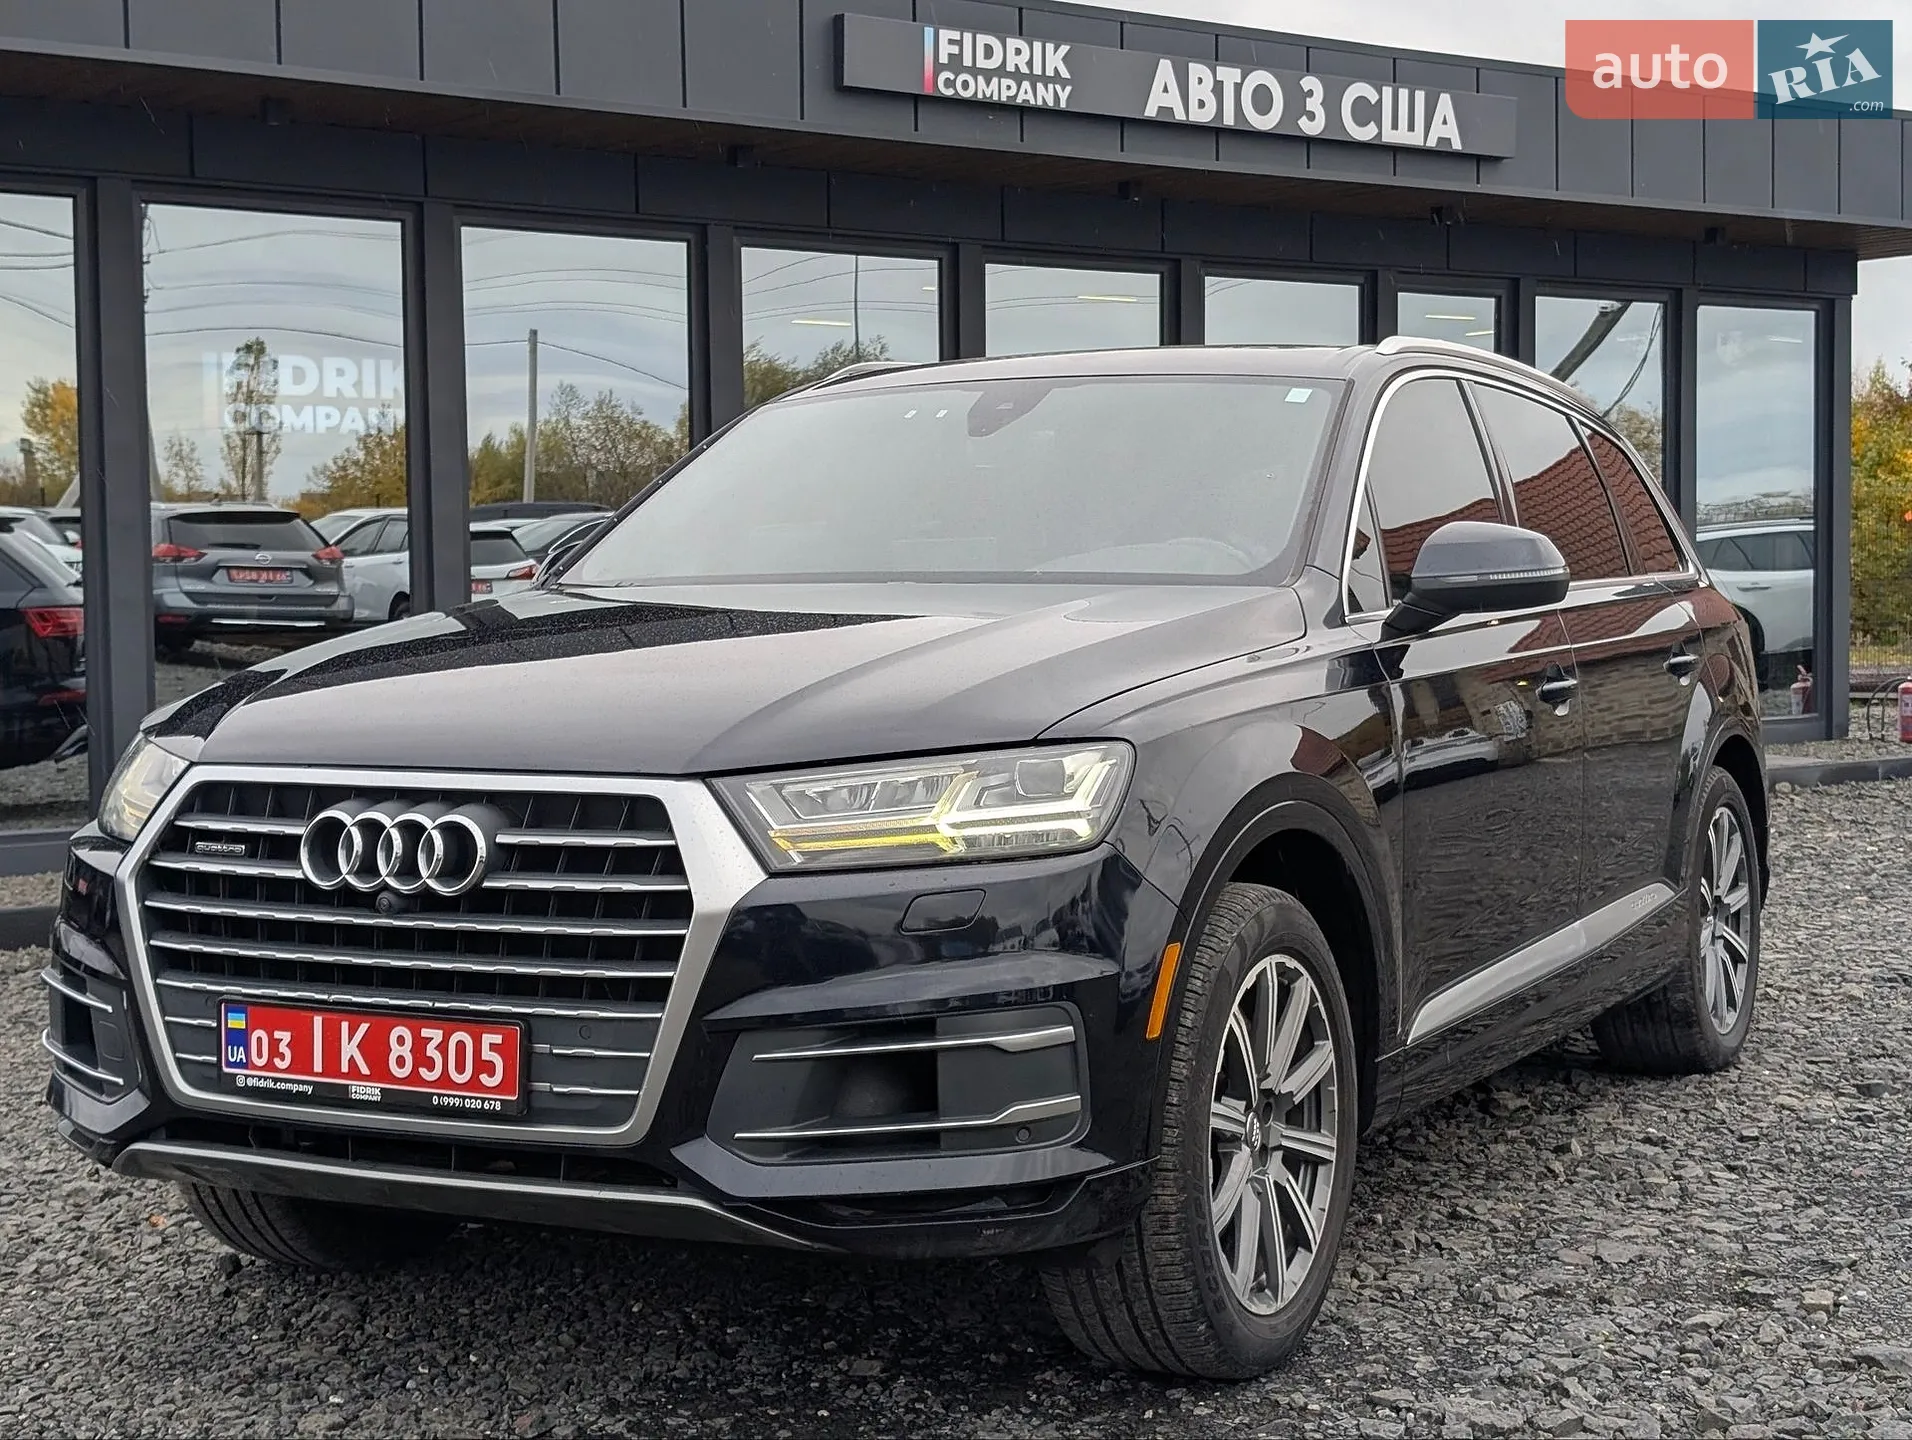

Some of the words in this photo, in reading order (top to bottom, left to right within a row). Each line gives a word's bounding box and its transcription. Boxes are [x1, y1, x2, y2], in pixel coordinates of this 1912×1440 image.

[937, 30, 1071, 79] FIDRIK
[937, 71, 1072, 108] COMPANY
[1143, 58, 1284, 131] АВТО
[1340, 82, 1463, 150] США
[227, 1045, 247, 1064] UA
[250, 1029, 292, 1070] 03
[388, 1025, 504, 1088] 8305
[351, 1086, 381, 1096] FIDRIK
[351, 1093, 382, 1102] COMPANY
[432, 1095, 438, 1105] 0
[440, 1096, 463, 1107] (999)
[465, 1098, 482, 1109] 020
[483, 1100, 501, 1111] 678
